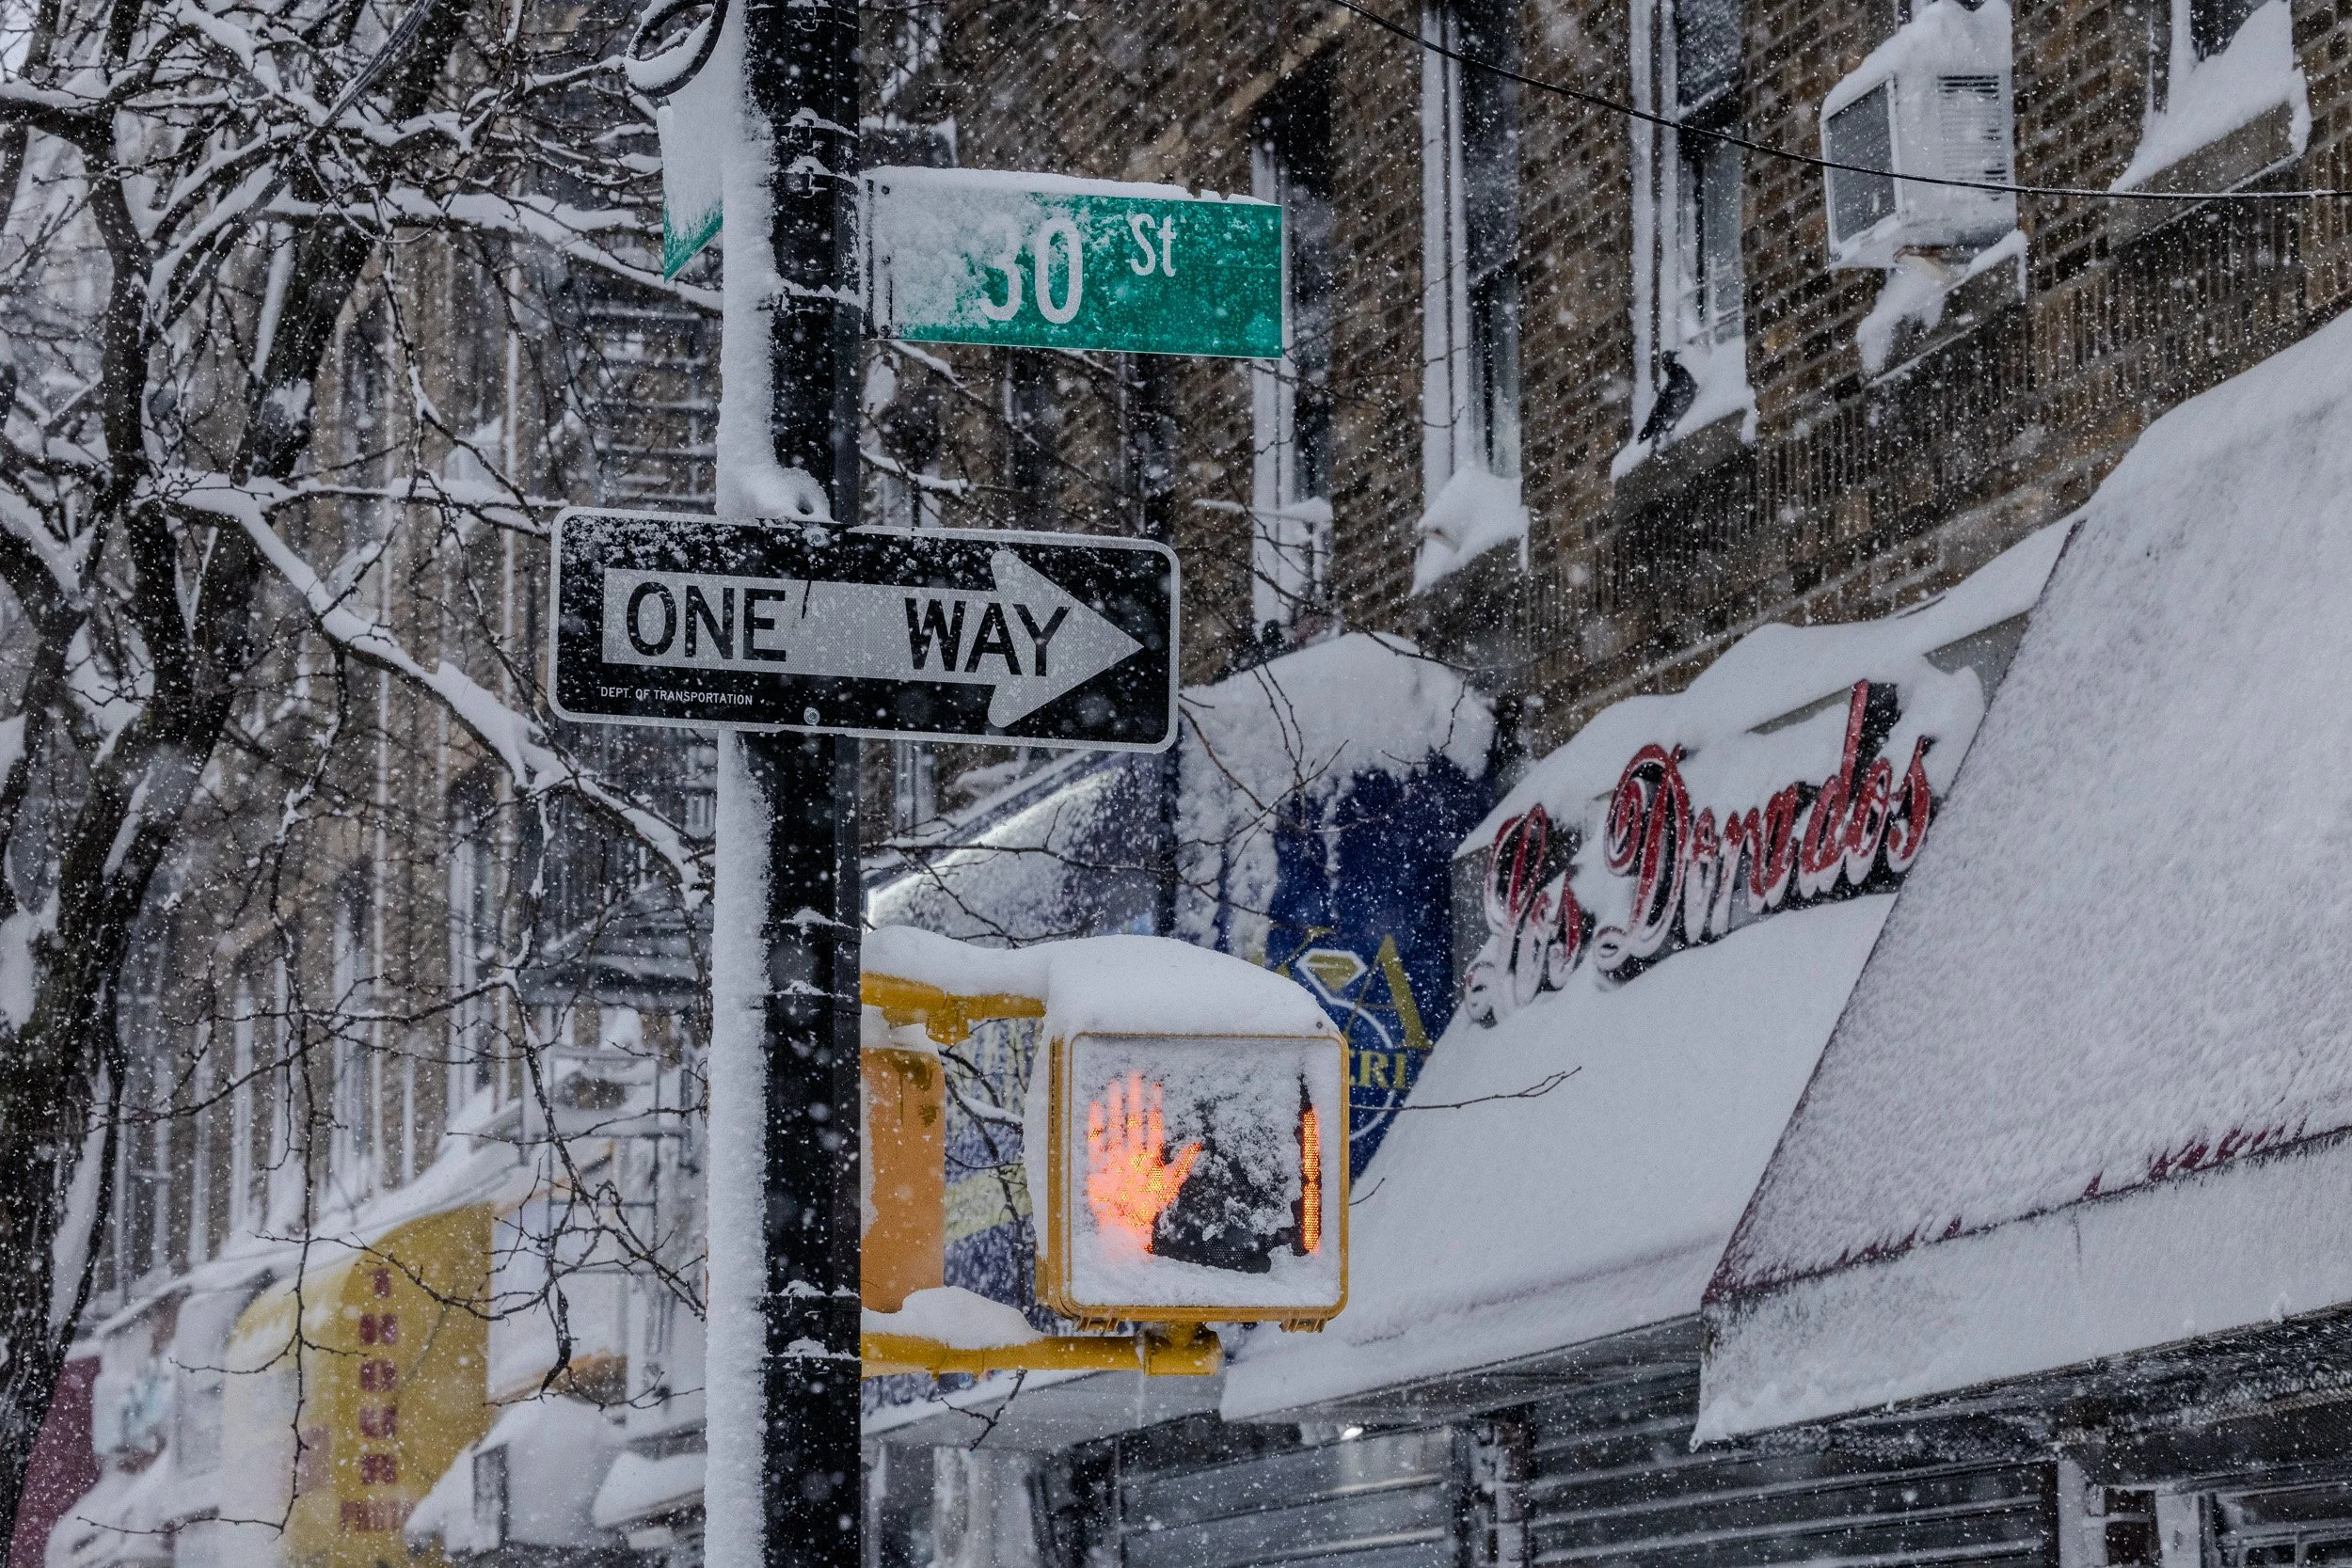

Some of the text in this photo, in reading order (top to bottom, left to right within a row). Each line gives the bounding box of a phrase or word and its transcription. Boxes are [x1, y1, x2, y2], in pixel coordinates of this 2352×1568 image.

[979, 213, 1177, 325] 30 St
[626, 581, 1071, 677] ONE WAY
[600, 686, 753, 705] DEPT. OF TRANSPORTATION
